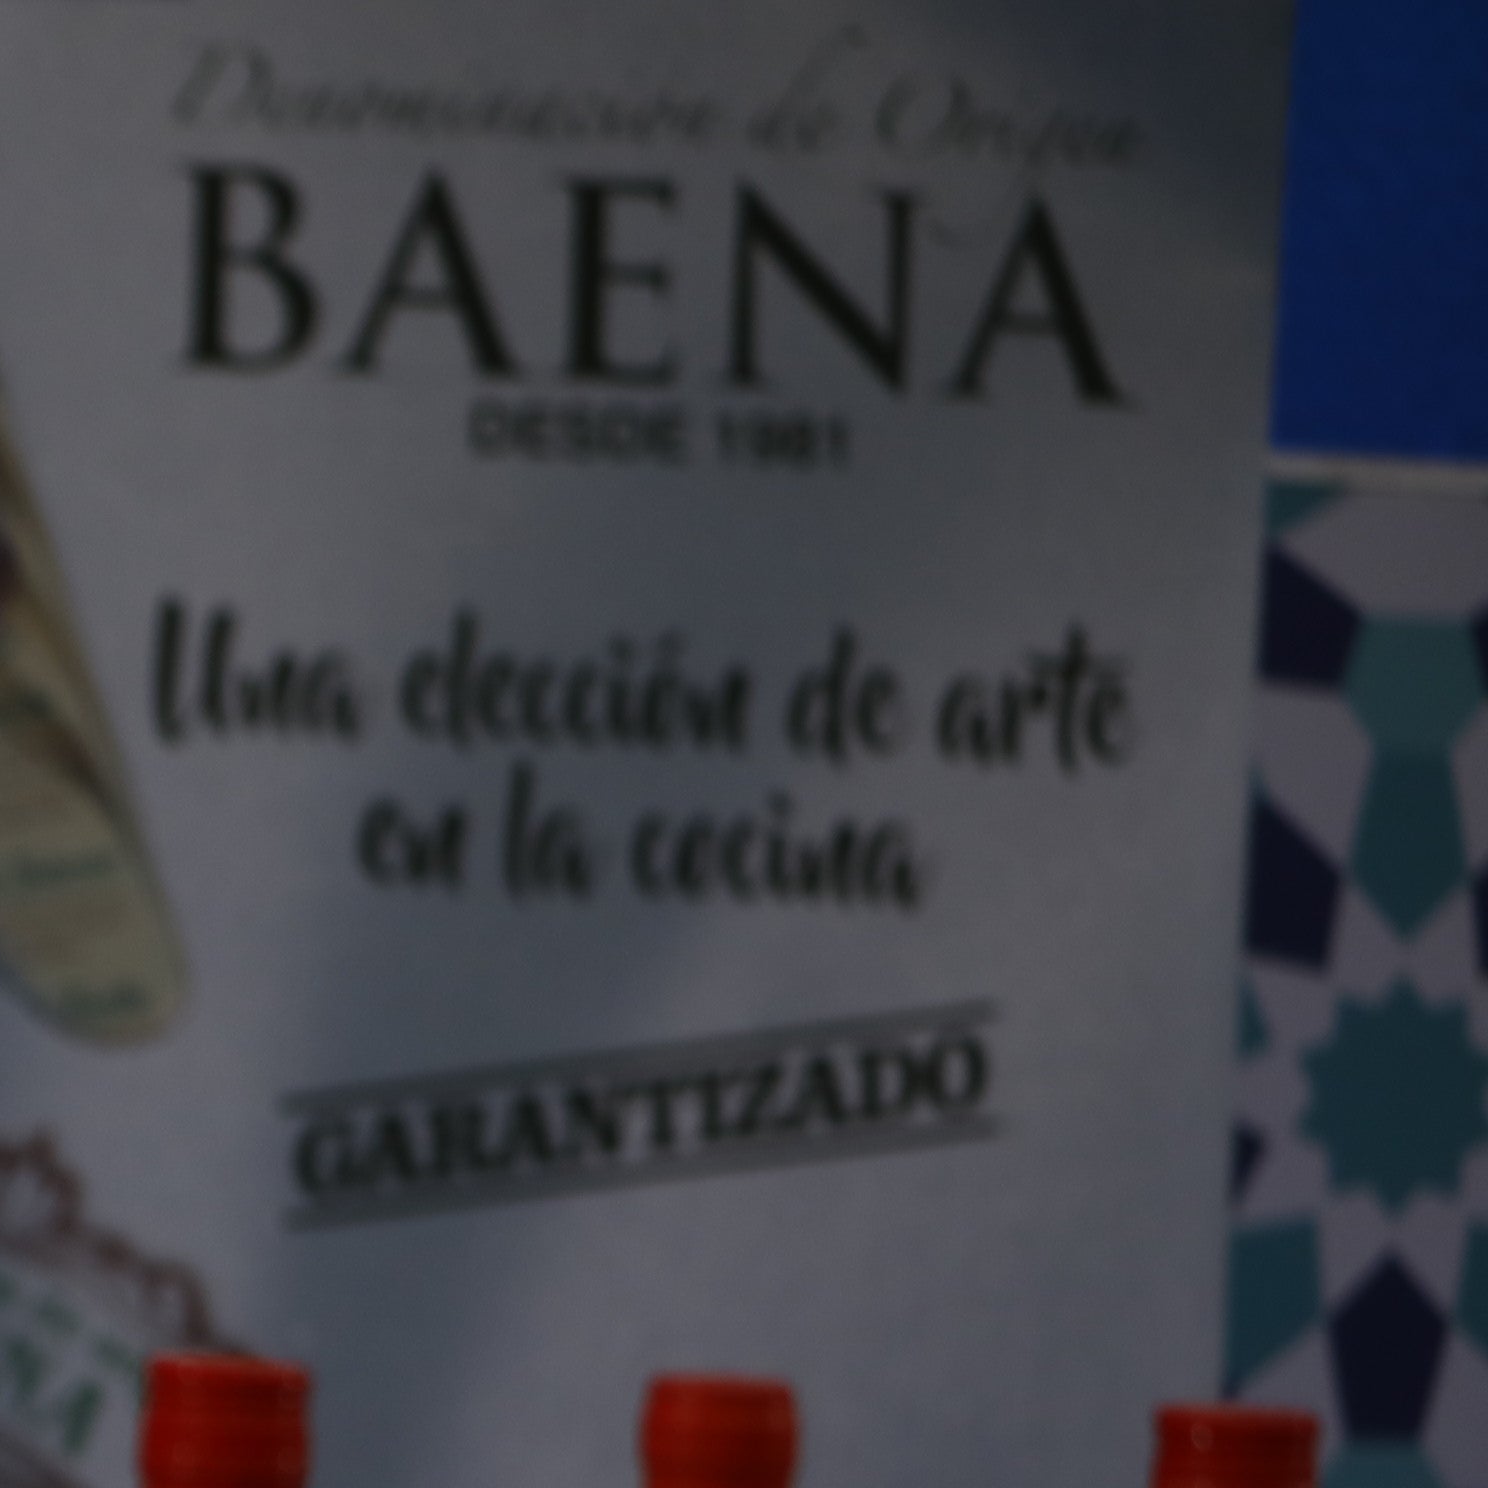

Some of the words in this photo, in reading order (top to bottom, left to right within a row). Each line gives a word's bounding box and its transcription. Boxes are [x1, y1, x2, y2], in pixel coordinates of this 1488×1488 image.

[179, 160, 1134, 406] BAENA
[468, 402, 688, 466] DESDE
[152, 598, 362, 742] Una
[400, 610, 752, 756] elección
[786, 622, 902, 766] de
[936, 622, 1136, 772] arte
[358, 792, 468, 892] en
[502, 764, 596, 904] la
[630, 794, 930, 904] cocina
[292, 1032, 990, 1202] GARANTIZADO
